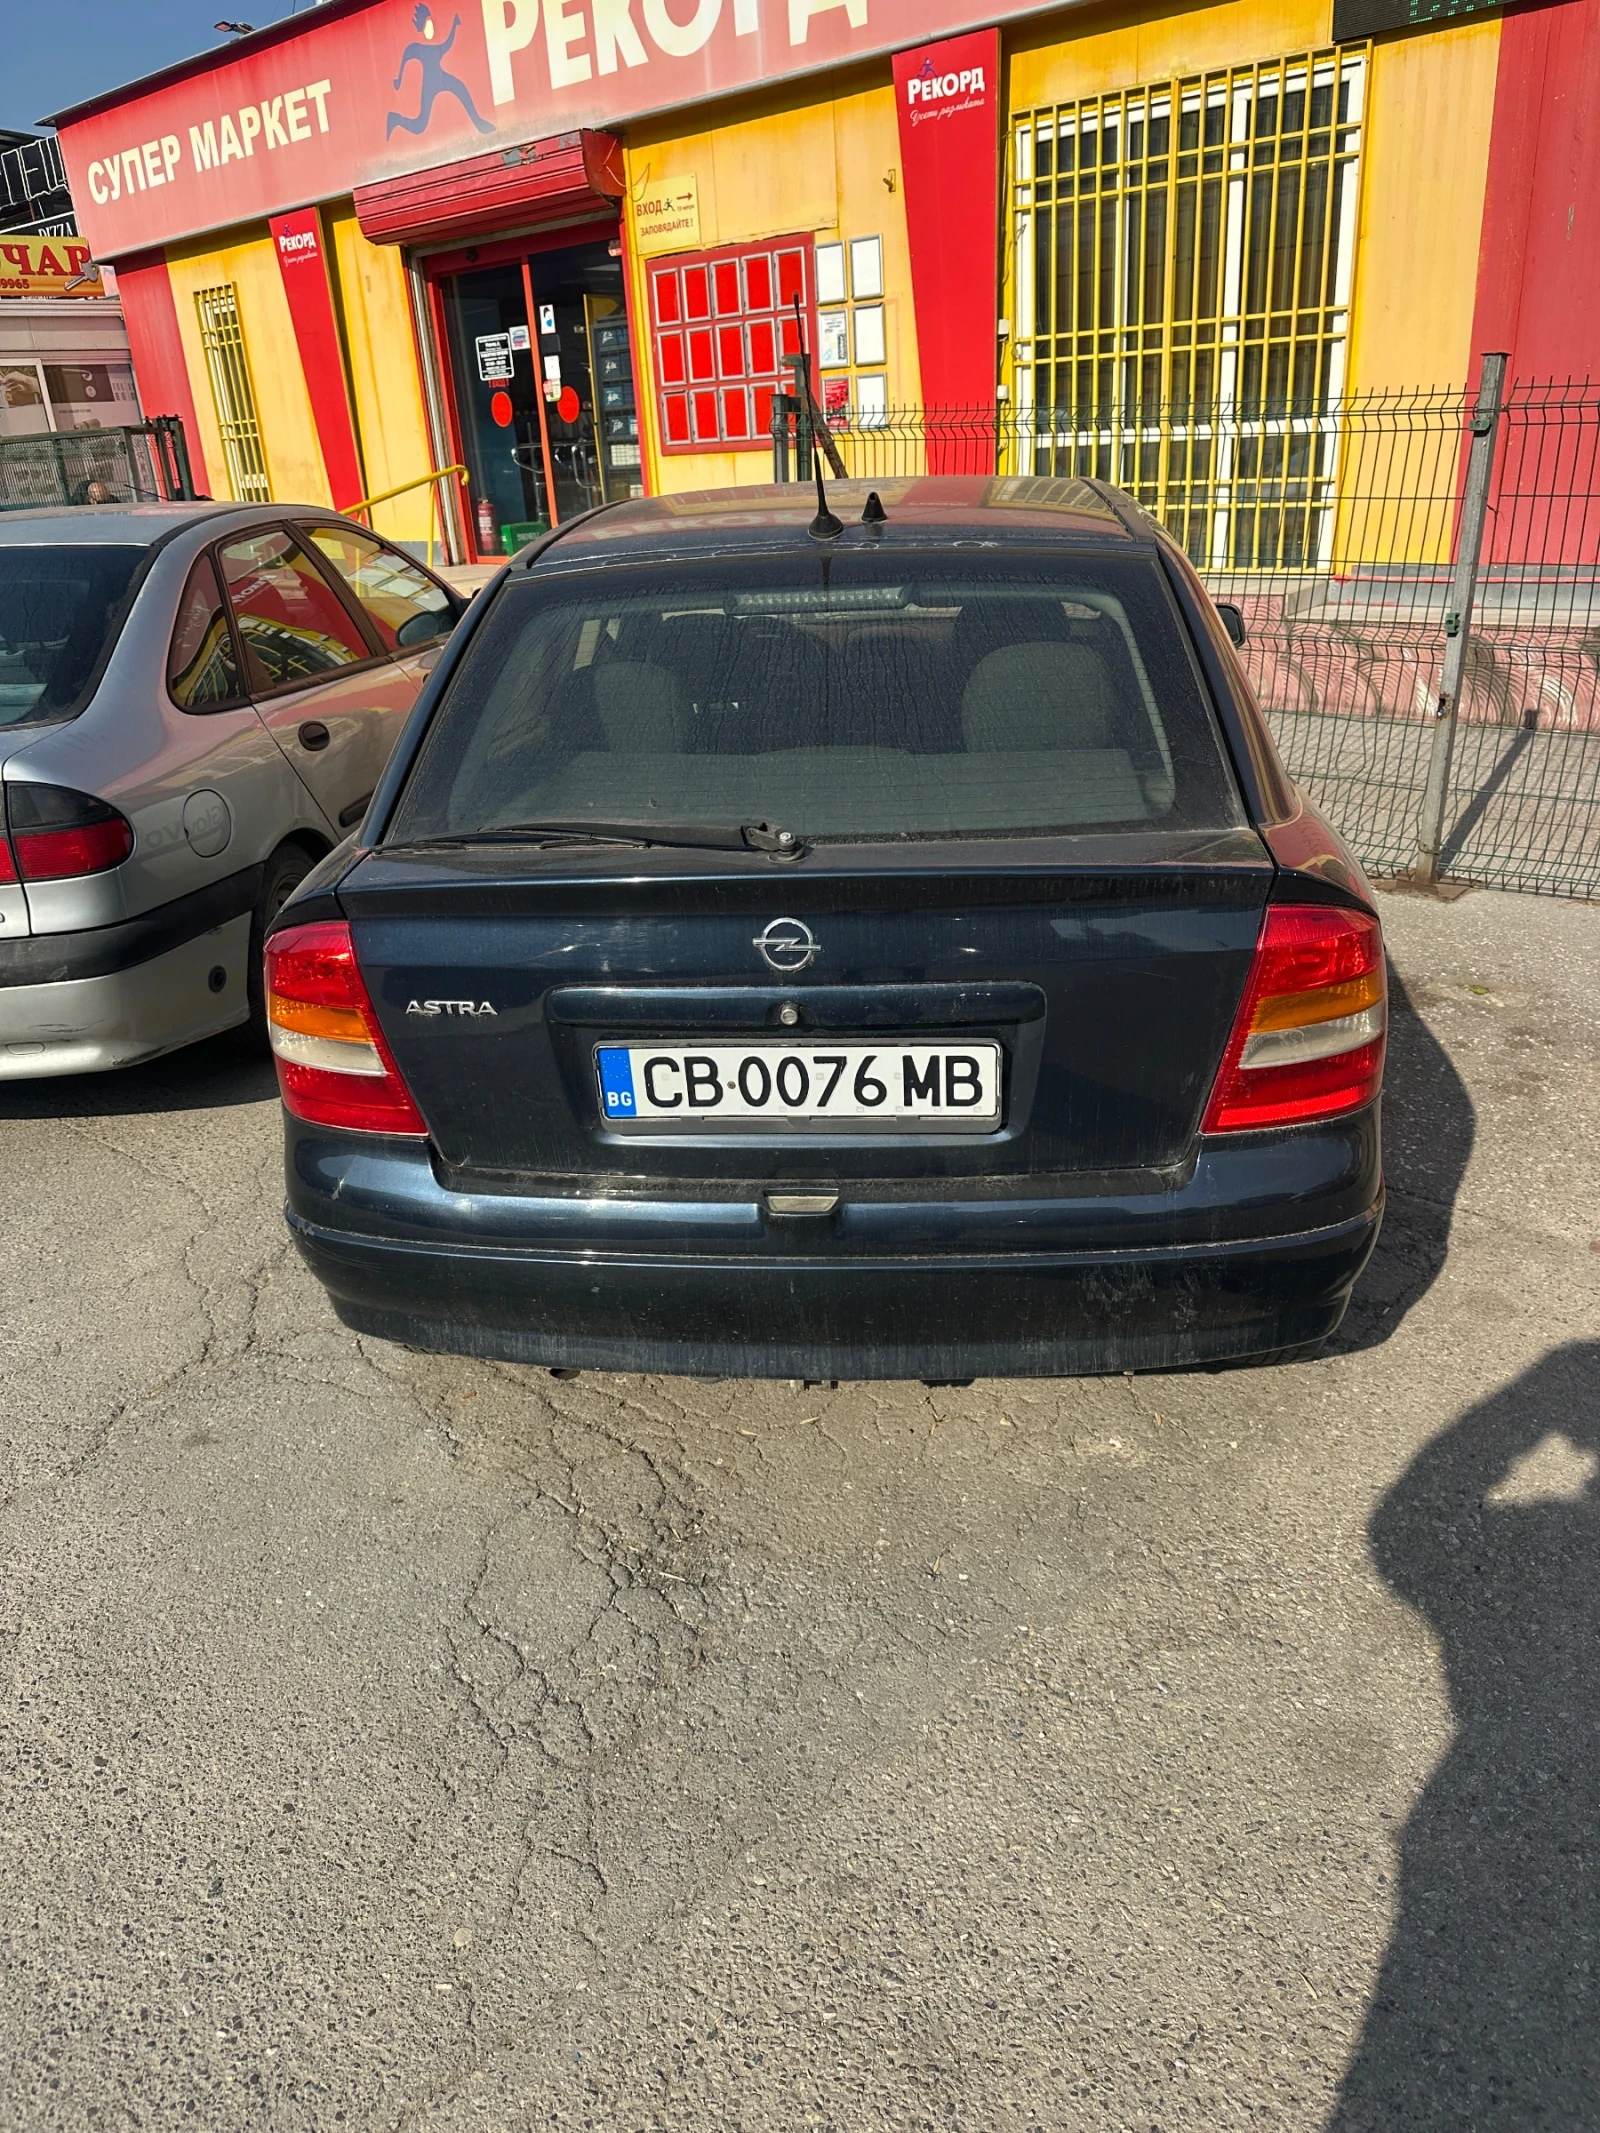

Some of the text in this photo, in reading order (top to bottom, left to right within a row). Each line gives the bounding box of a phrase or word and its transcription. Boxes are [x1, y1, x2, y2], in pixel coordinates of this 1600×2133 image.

[907, 67, 985, 105] РЕКОРД
[88, 134, 181, 204] СУПЕР
[188, 79, 332, 174] МАРКЕТ
[636, 199, 663, 217] ВХОД
[640, 218, 689, 237] ЗАПОВЯДАЙТЕ
[279, 231, 316, 253] РЕКОРД
[0, 244, 90, 276] ЧАР
[0, 277, 30, 290] 9965
[404, 999, 499, 1018] ASTRA
[643, 1054, 984, 1109] CB 0076 MB
[606, 1090, 633, 1108] BG
